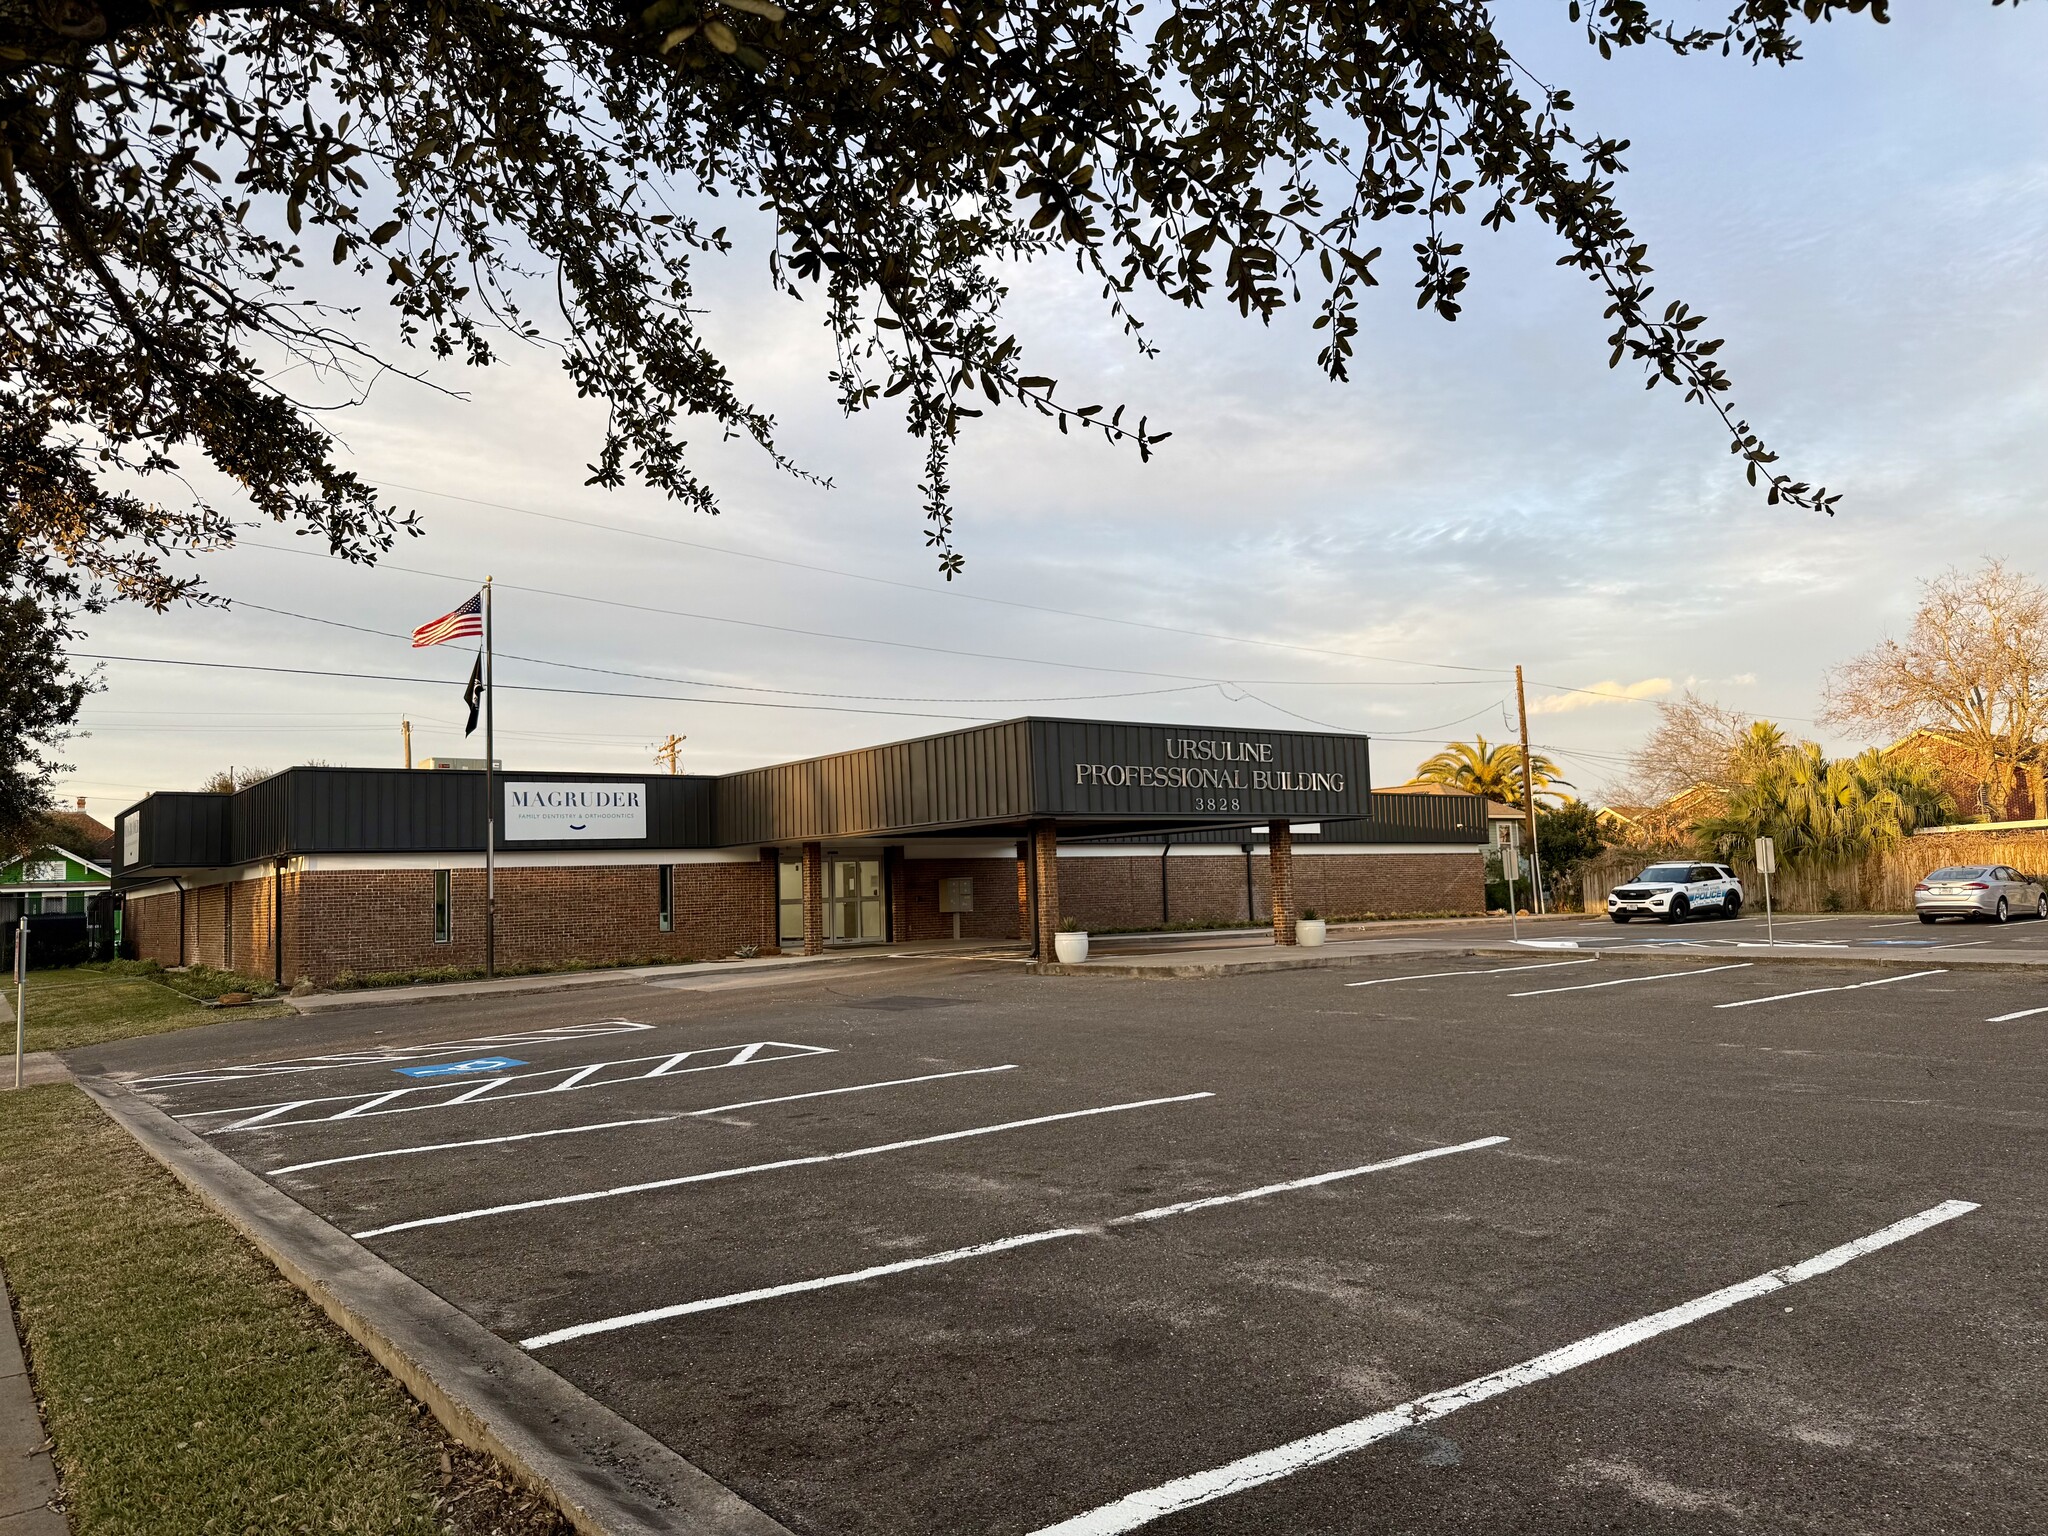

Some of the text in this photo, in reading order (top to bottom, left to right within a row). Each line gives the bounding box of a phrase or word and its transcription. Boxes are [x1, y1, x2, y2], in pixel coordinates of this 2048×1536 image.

[1166, 738, 1274, 763] URSULINE
[1075, 764, 1345, 793] PROFESSIONAL BUILDING
[511, 791, 640, 807] MAGRUDER
[1195, 798, 1240, 811] 3828
[1694, 890, 1722, 901] POLICE
